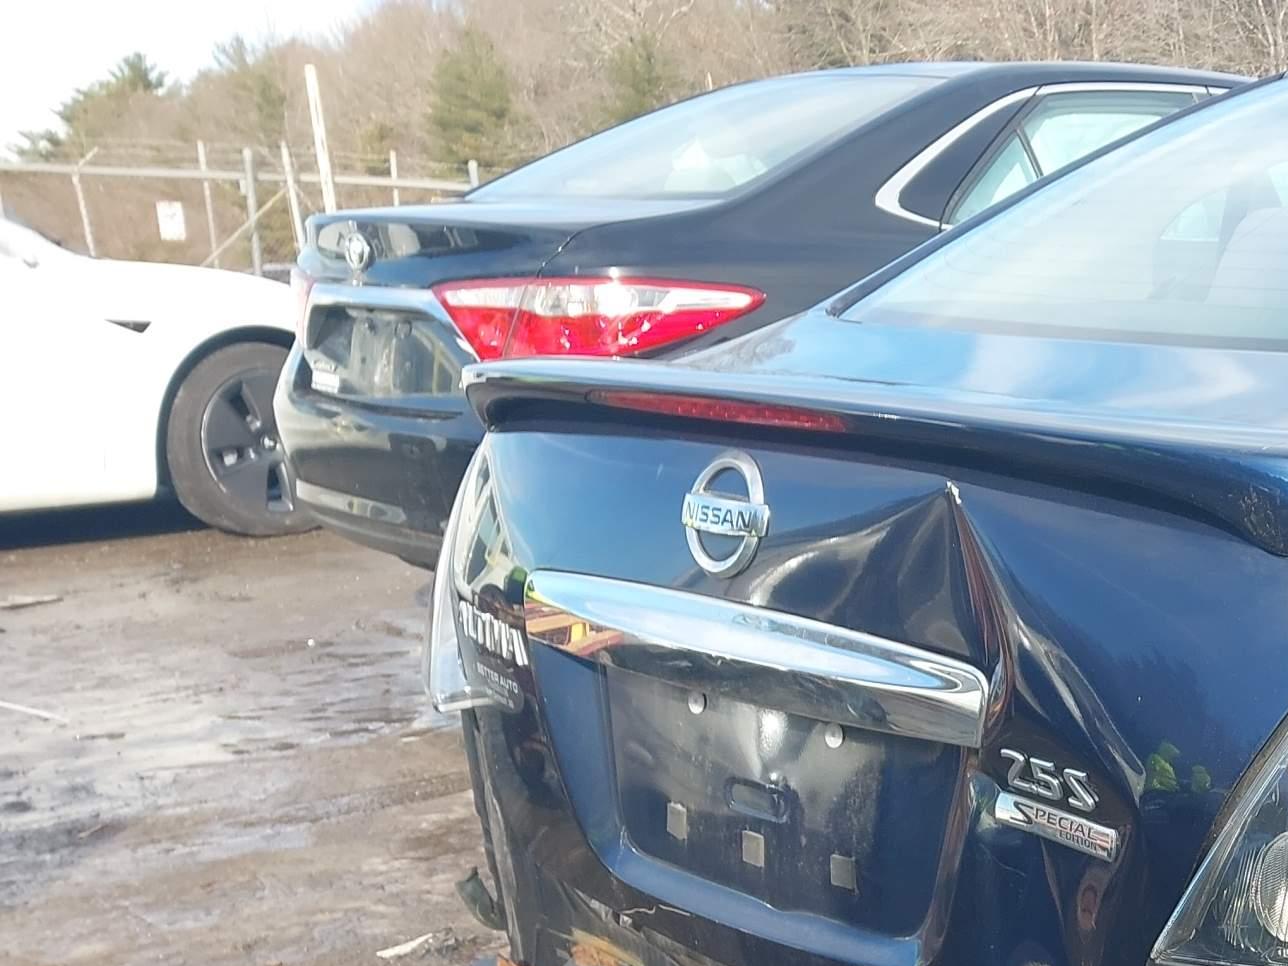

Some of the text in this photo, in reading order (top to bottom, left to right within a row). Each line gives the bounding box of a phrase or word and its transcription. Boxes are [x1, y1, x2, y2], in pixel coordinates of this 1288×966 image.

[685, 501, 751, 529] NISSAN
[500, 674, 519, 694] AUTO
[1009, 800, 1099, 841] SPECIAL
[1058, 831, 1098, 851] EDITION
